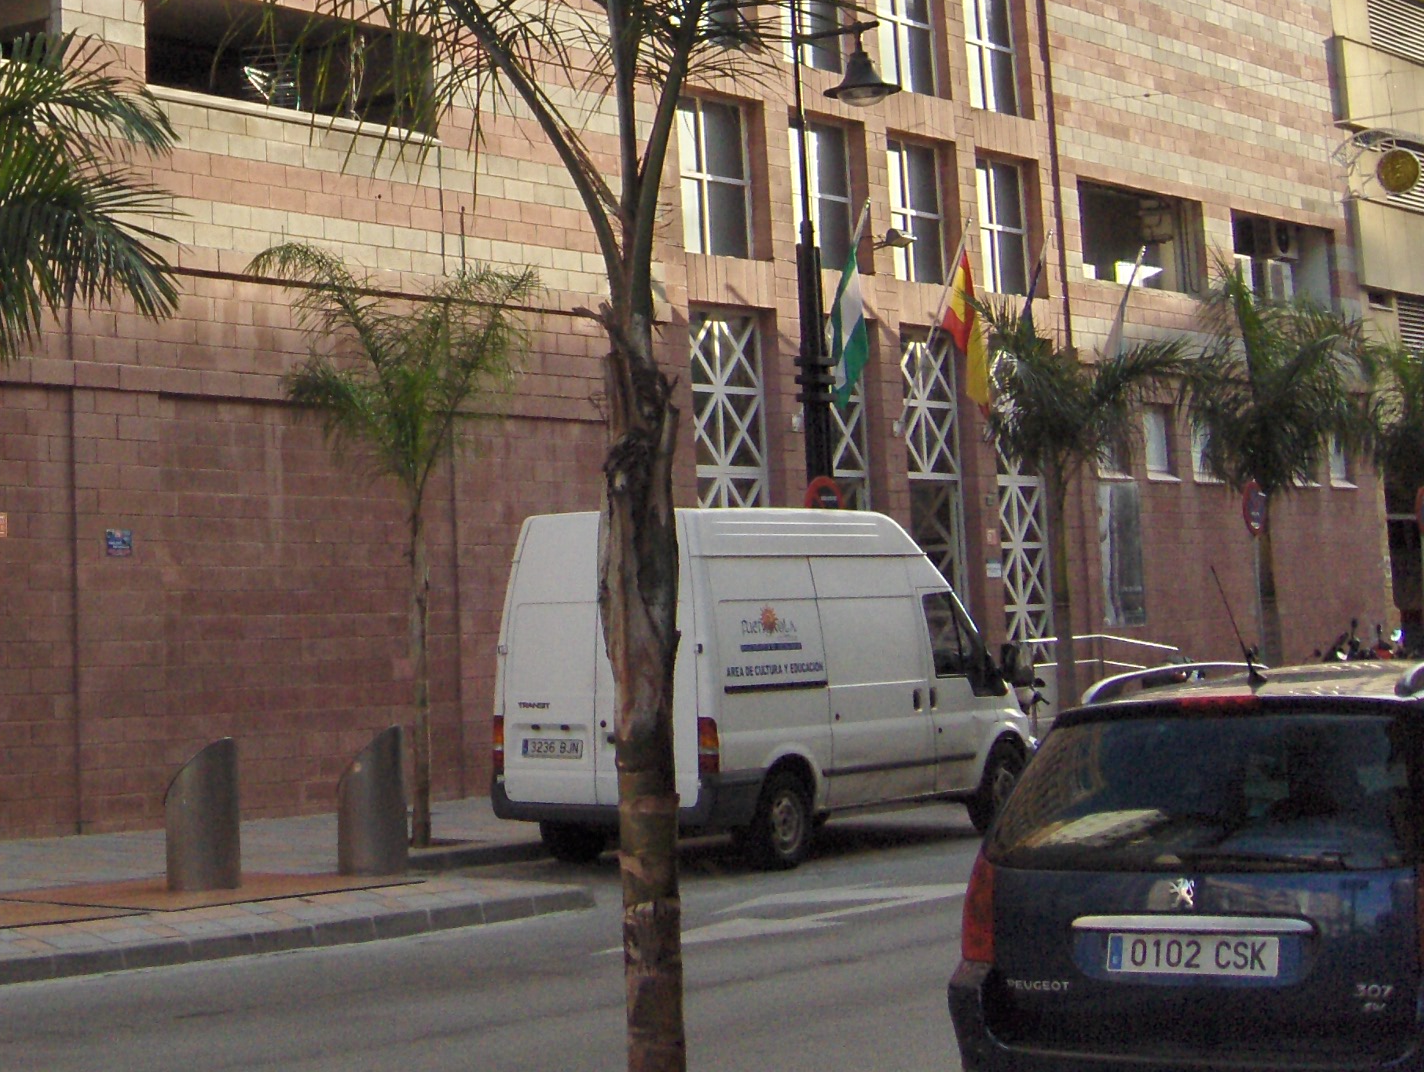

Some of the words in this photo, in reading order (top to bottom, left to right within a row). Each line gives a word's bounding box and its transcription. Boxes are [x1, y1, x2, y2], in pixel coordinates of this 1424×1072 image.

[726, 666, 744, 677] AREA
[745, 665, 754, 677] DE
[754, 664, 783, 676] CULTURA
[783, 663, 789, 674] Y
[518, 701, 550, 709] TRANSIT
[530, 741, 556, 754] 3236
[1129, 938, 1201, 969] 0102
[1214, 940, 1268, 971] CSK
[1006, 978, 1070, 992] PEUGEOT
[1355, 983, 1394, 998] 307
